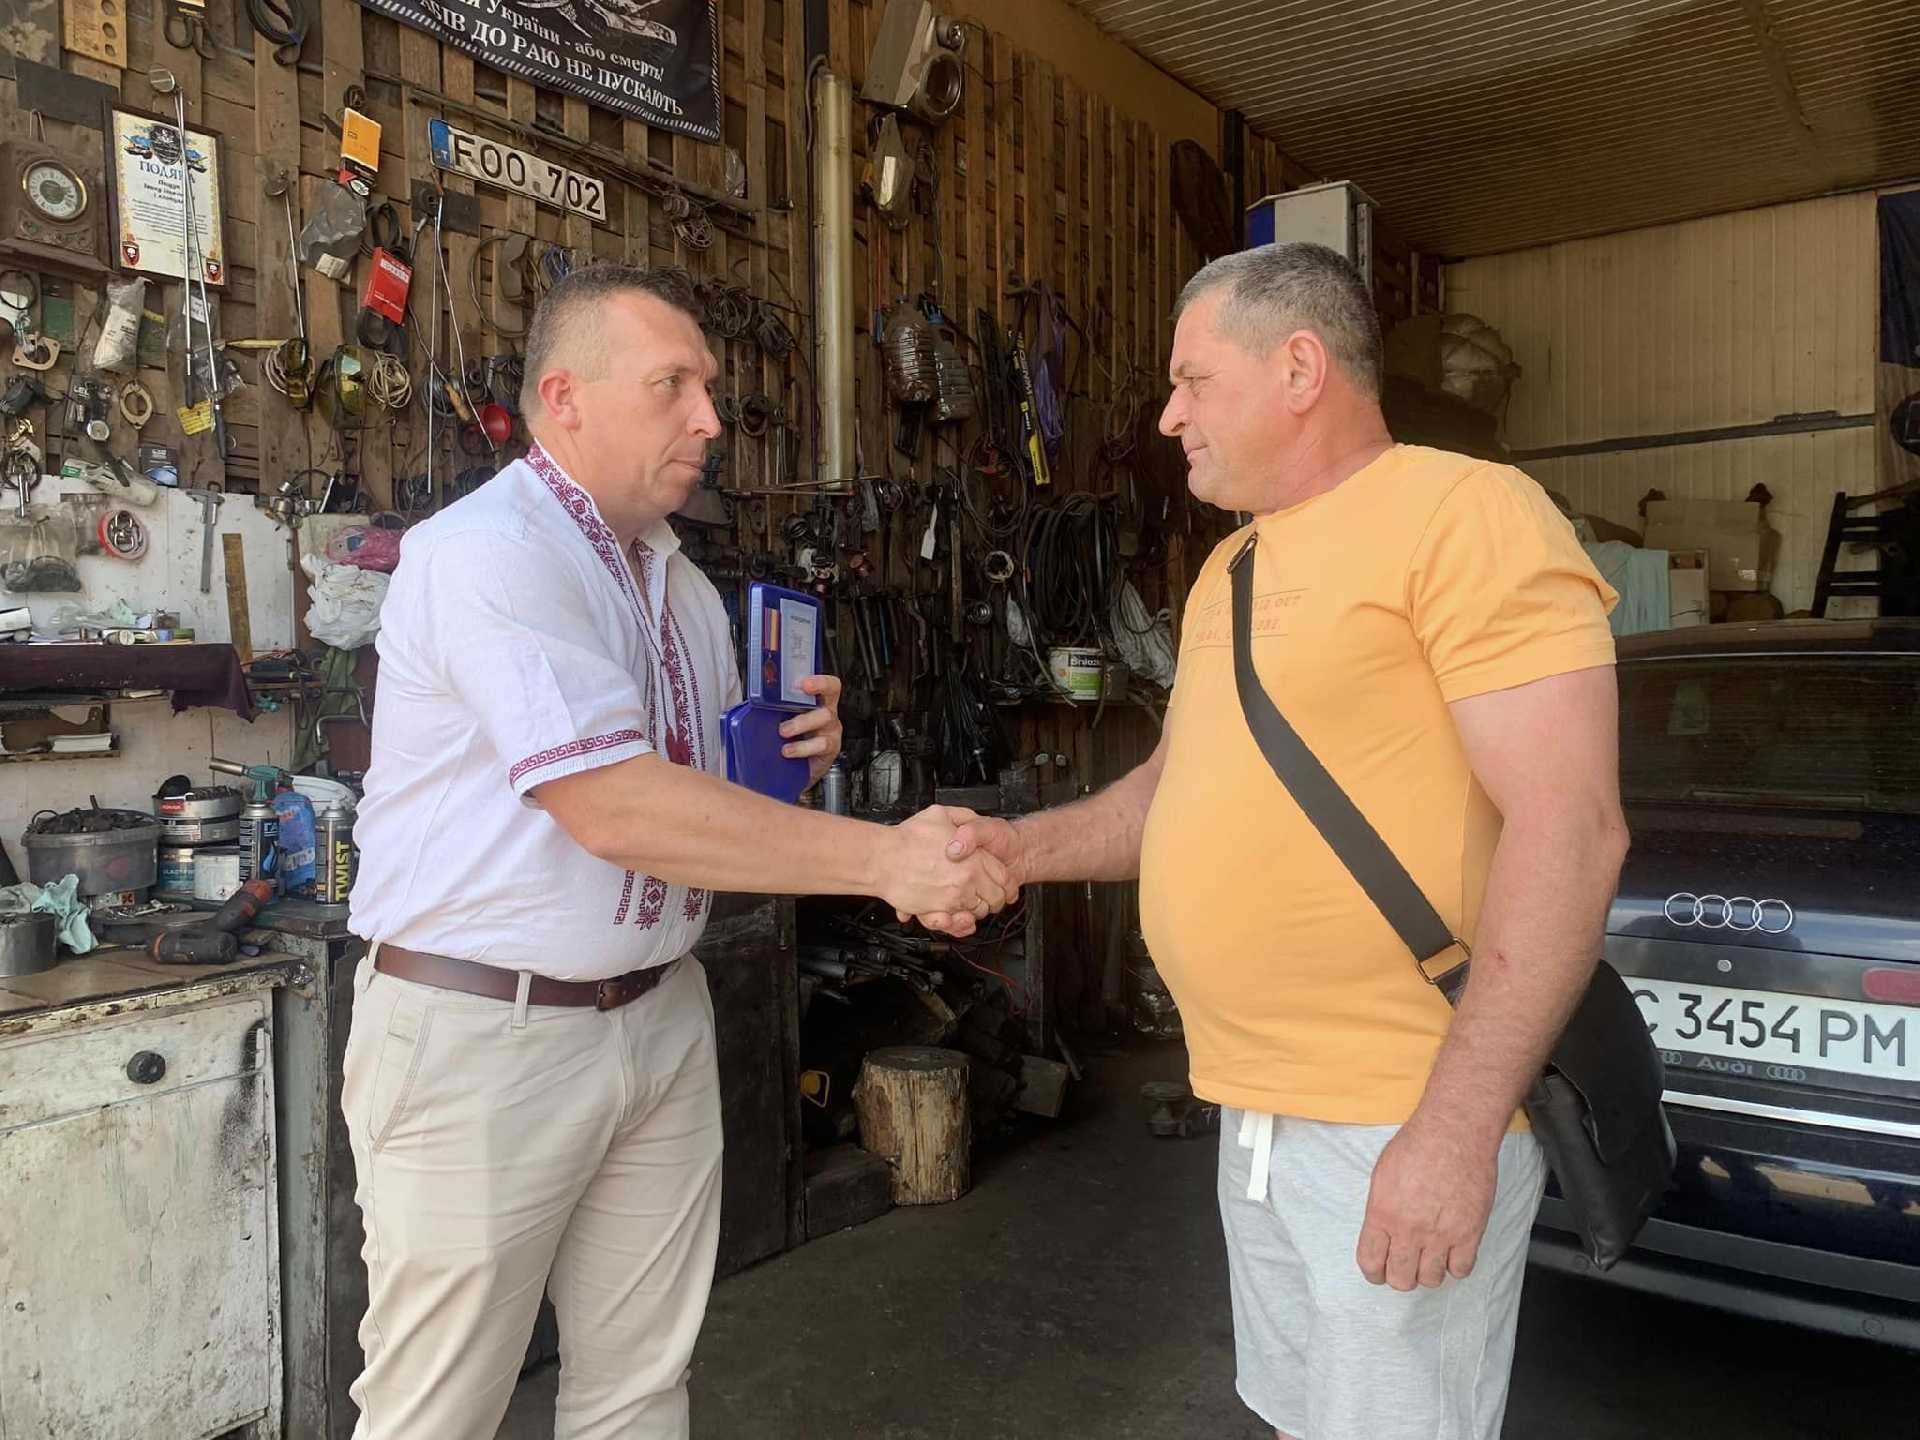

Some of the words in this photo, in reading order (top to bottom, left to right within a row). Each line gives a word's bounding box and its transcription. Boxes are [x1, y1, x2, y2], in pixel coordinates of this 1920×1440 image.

[471, 20, 507, 47] ДО
[511, 34, 560, 69] РАЮ
[565, 57, 593, 80] НЕ
[597, 67, 684, 116] ПУСКАЮТЬ
[575, 42, 606, 62] або
[610, 53, 665, 82] смерть!
[139, 160, 195, 184] ПОДЯ
[453, 134, 526, 188] FOO
[547, 166, 602, 213] 702
[335, 840, 350, 902] TWIST
[1675, 992, 1801, 1054] 3454
[1819, 1008, 1906, 1067] PM
[1696, 1054, 1753, 1075] Audi
